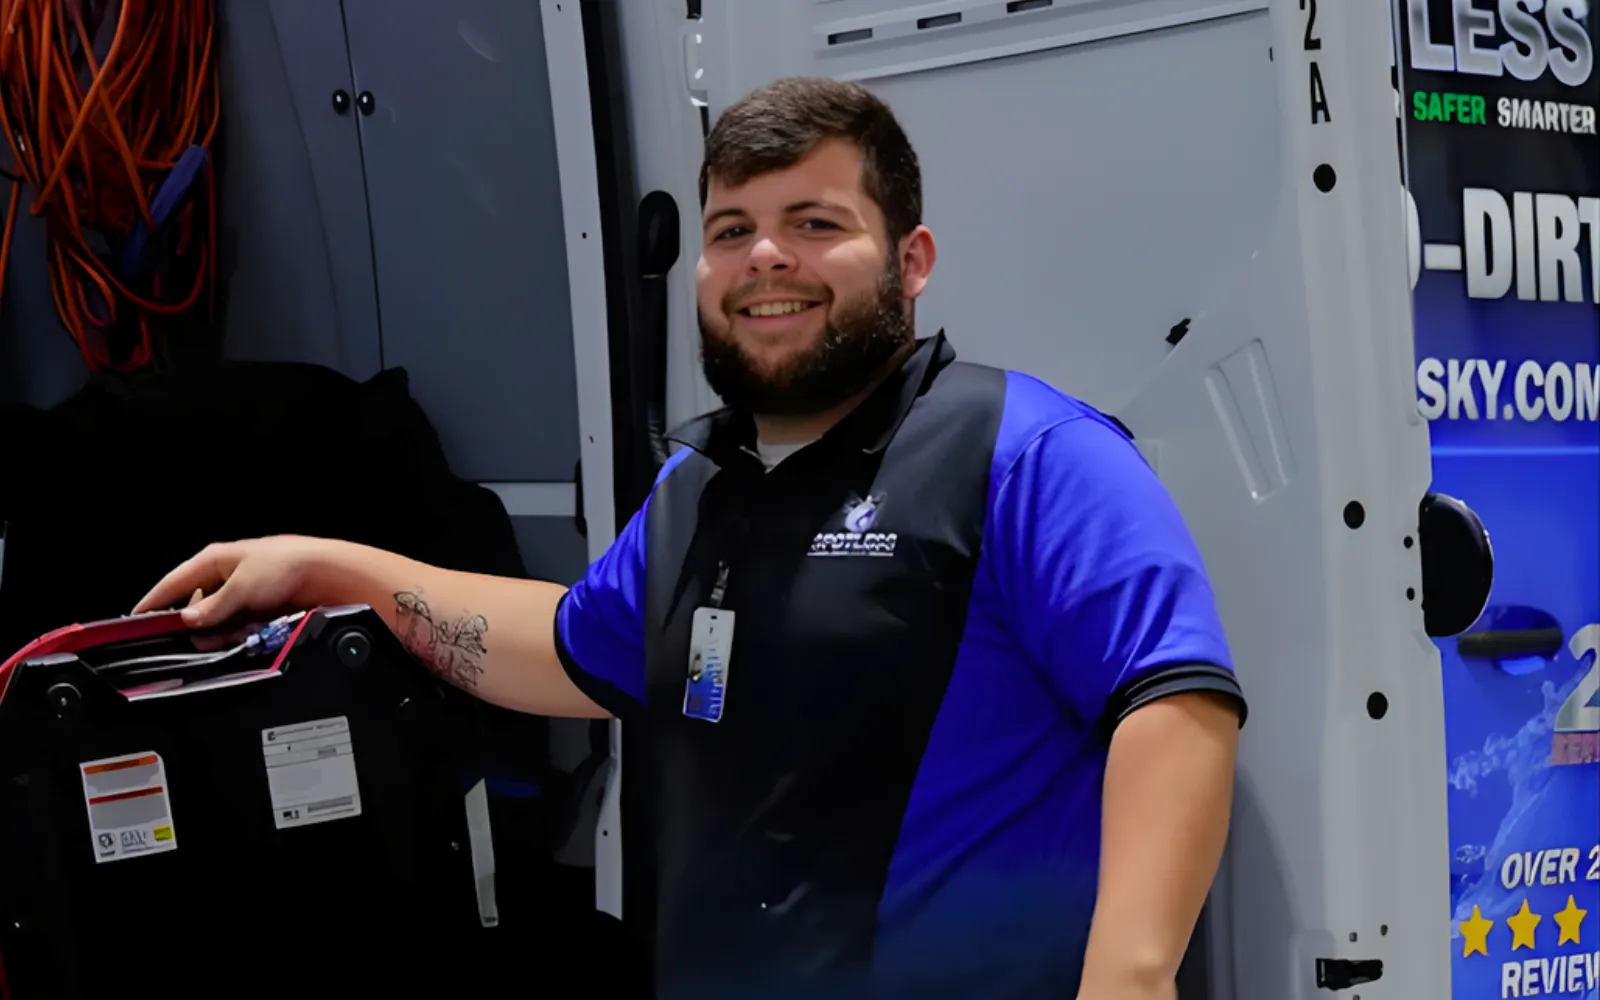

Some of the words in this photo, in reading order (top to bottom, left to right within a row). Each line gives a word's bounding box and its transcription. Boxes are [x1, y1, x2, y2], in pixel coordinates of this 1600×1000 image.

[1407, 0, 1593, 87] LESS
[1413, 91, 1486, 125] SAFER
[1497, 97, 1596, 134] SMARTER
[1501, 848, 1580, 889] OVER
